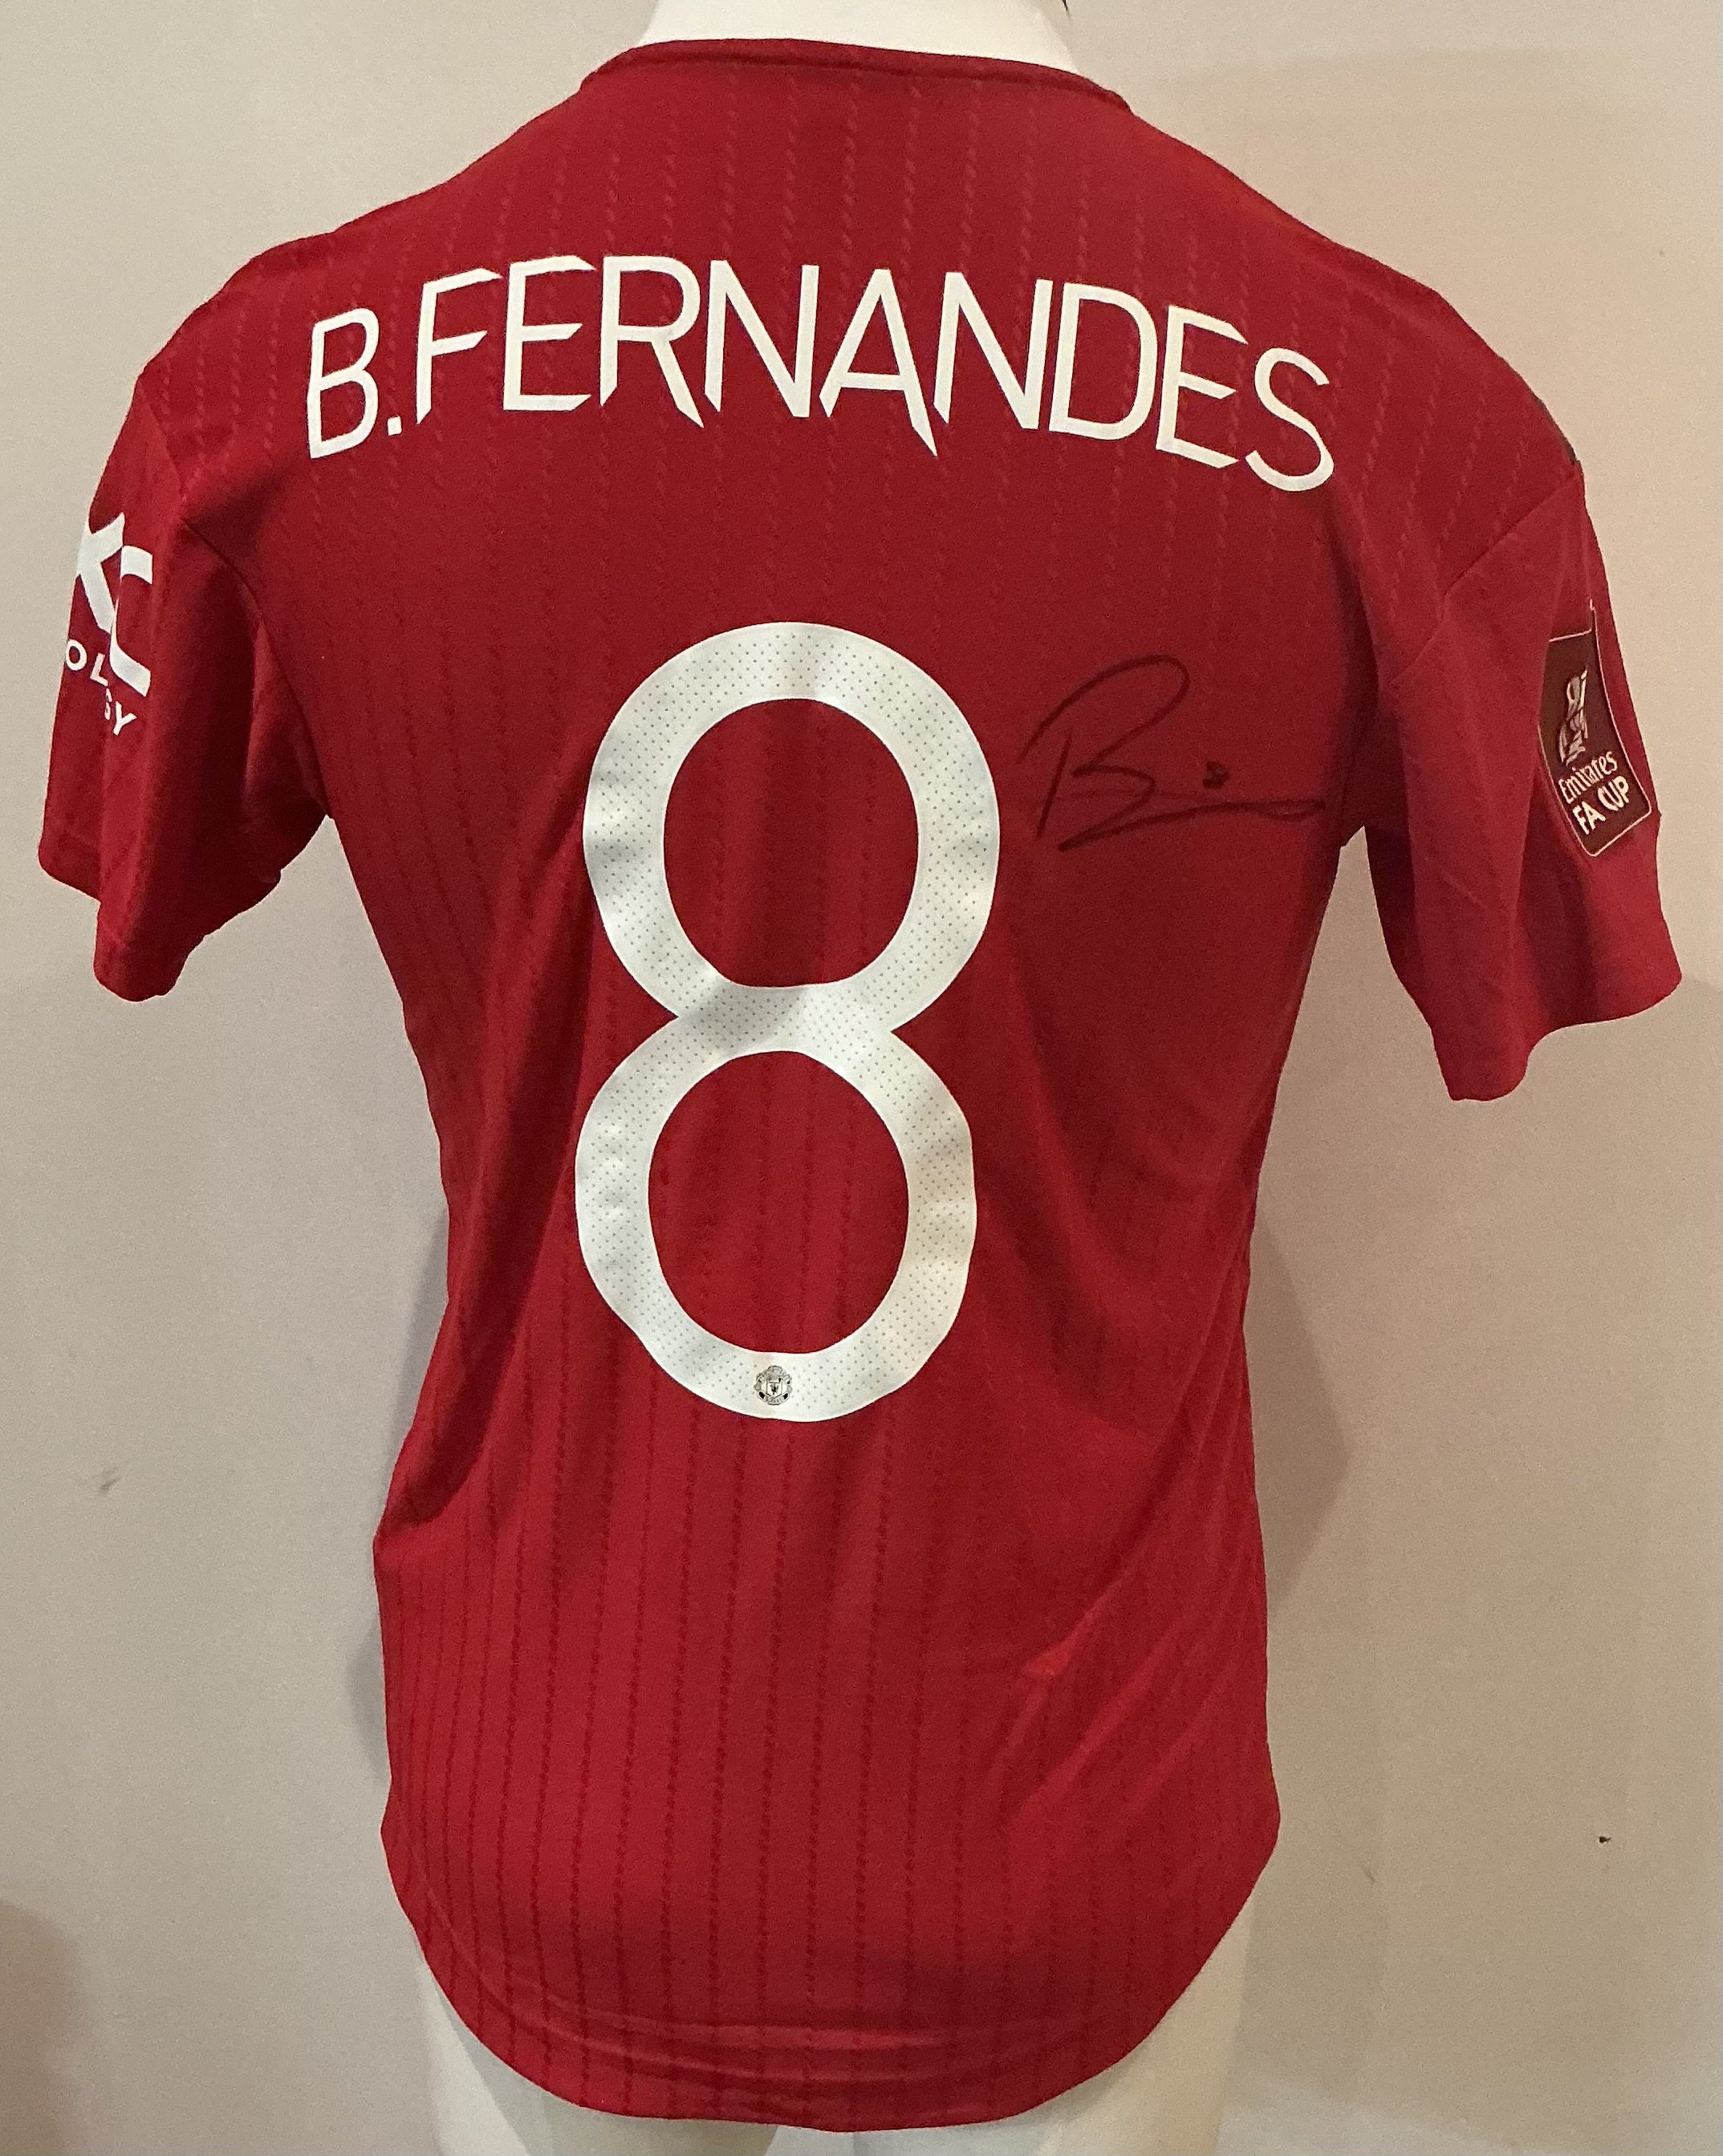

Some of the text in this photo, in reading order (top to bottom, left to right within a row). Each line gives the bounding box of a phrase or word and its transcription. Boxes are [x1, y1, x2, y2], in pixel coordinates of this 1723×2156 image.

[307, 254, 1335, 492] B.FERNANDES
[1558, 751, 1618, 804] Emirates
[1571, 775, 1631, 835] FA CUP
[575, 621, 998, 1423] 8
